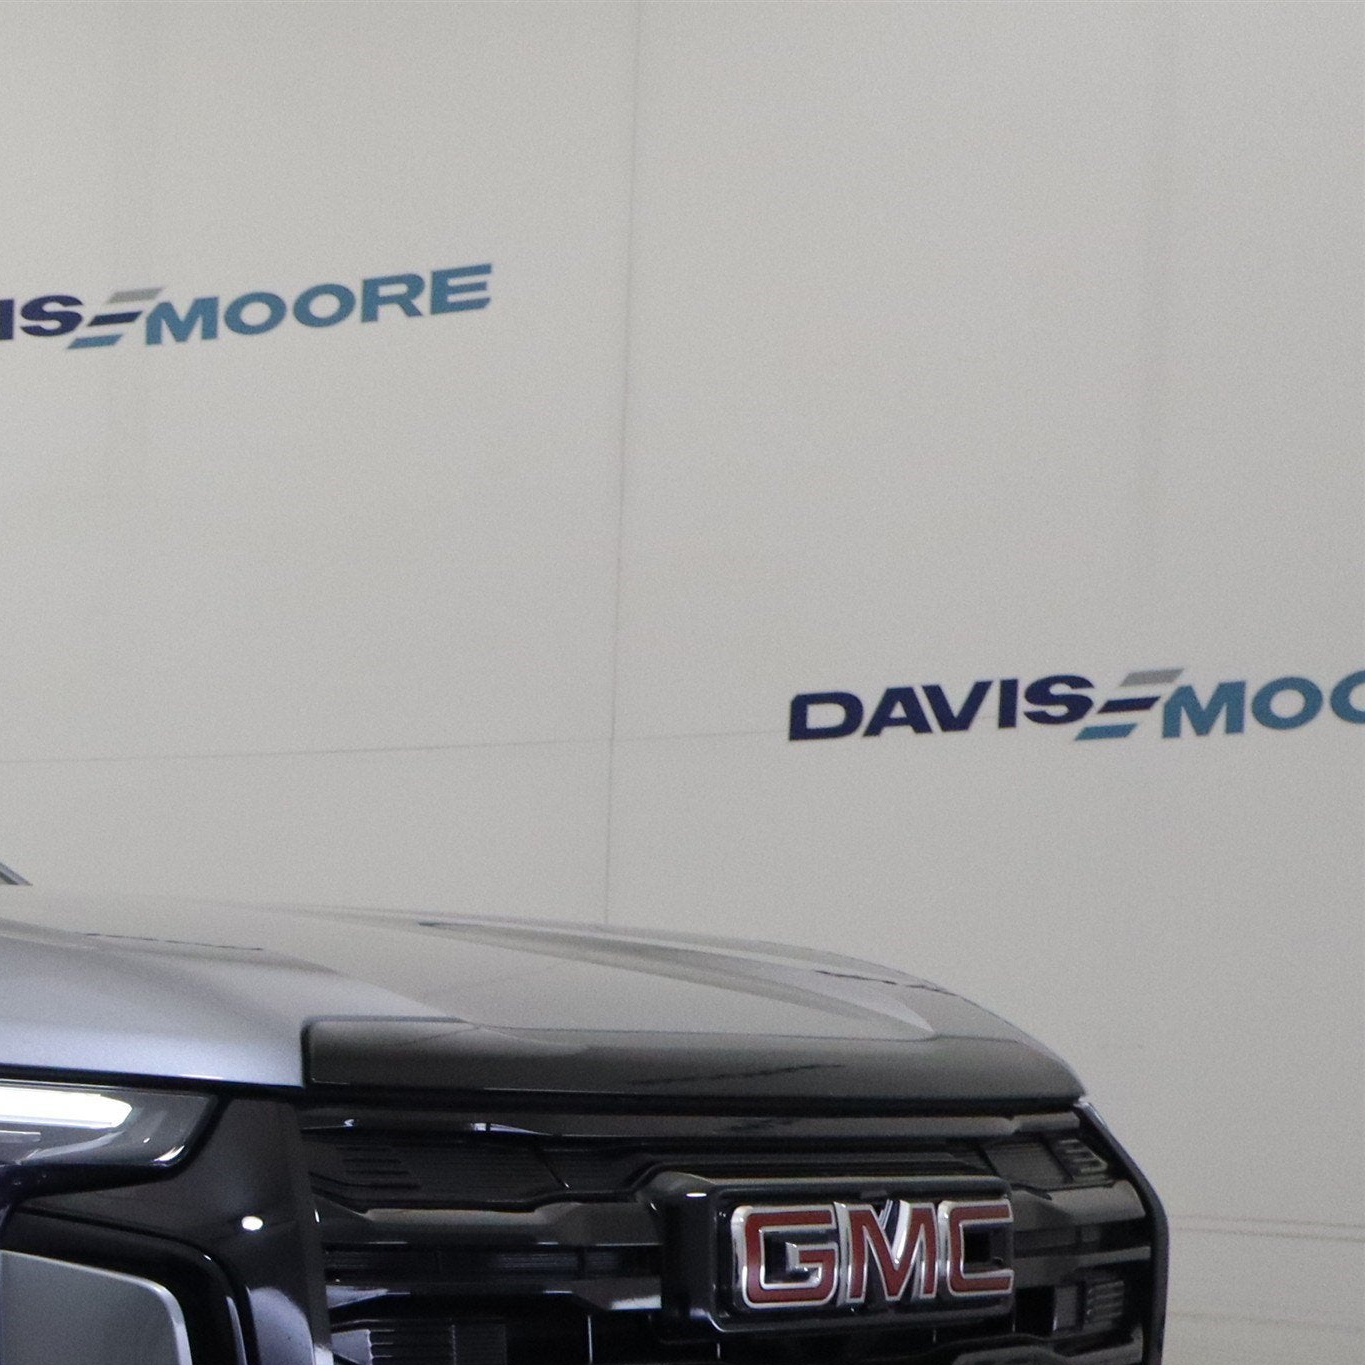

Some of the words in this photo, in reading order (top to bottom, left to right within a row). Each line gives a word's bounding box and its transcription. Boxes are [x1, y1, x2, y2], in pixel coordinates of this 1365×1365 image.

[145, 263, 493, 346] MOORE
[787, 673, 1096, 741] DAVIS
[730, 1199, 1015, 1310] GMC
